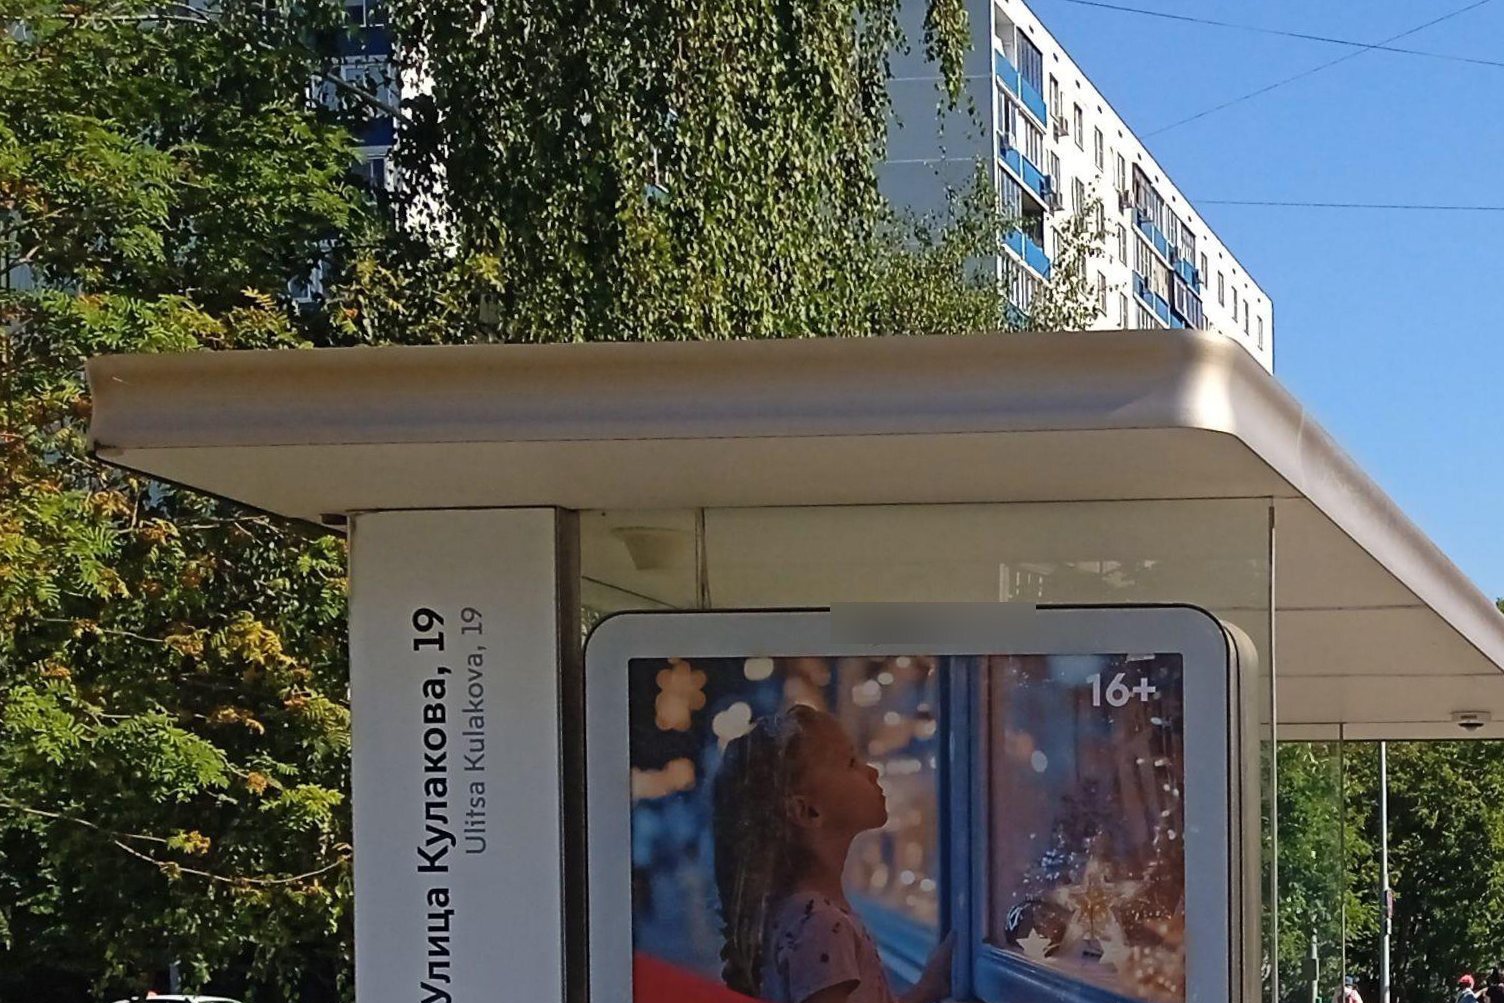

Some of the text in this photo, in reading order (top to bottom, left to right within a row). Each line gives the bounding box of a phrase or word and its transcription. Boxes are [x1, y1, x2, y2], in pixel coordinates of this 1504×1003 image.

[411, 607, 446, 652] 19
[1085, 672, 1157, 708] 16+
[416, 666, 456, 873] Кулакова,
[460, 606, 488, 854] Ulitsa Kulakova, 19
